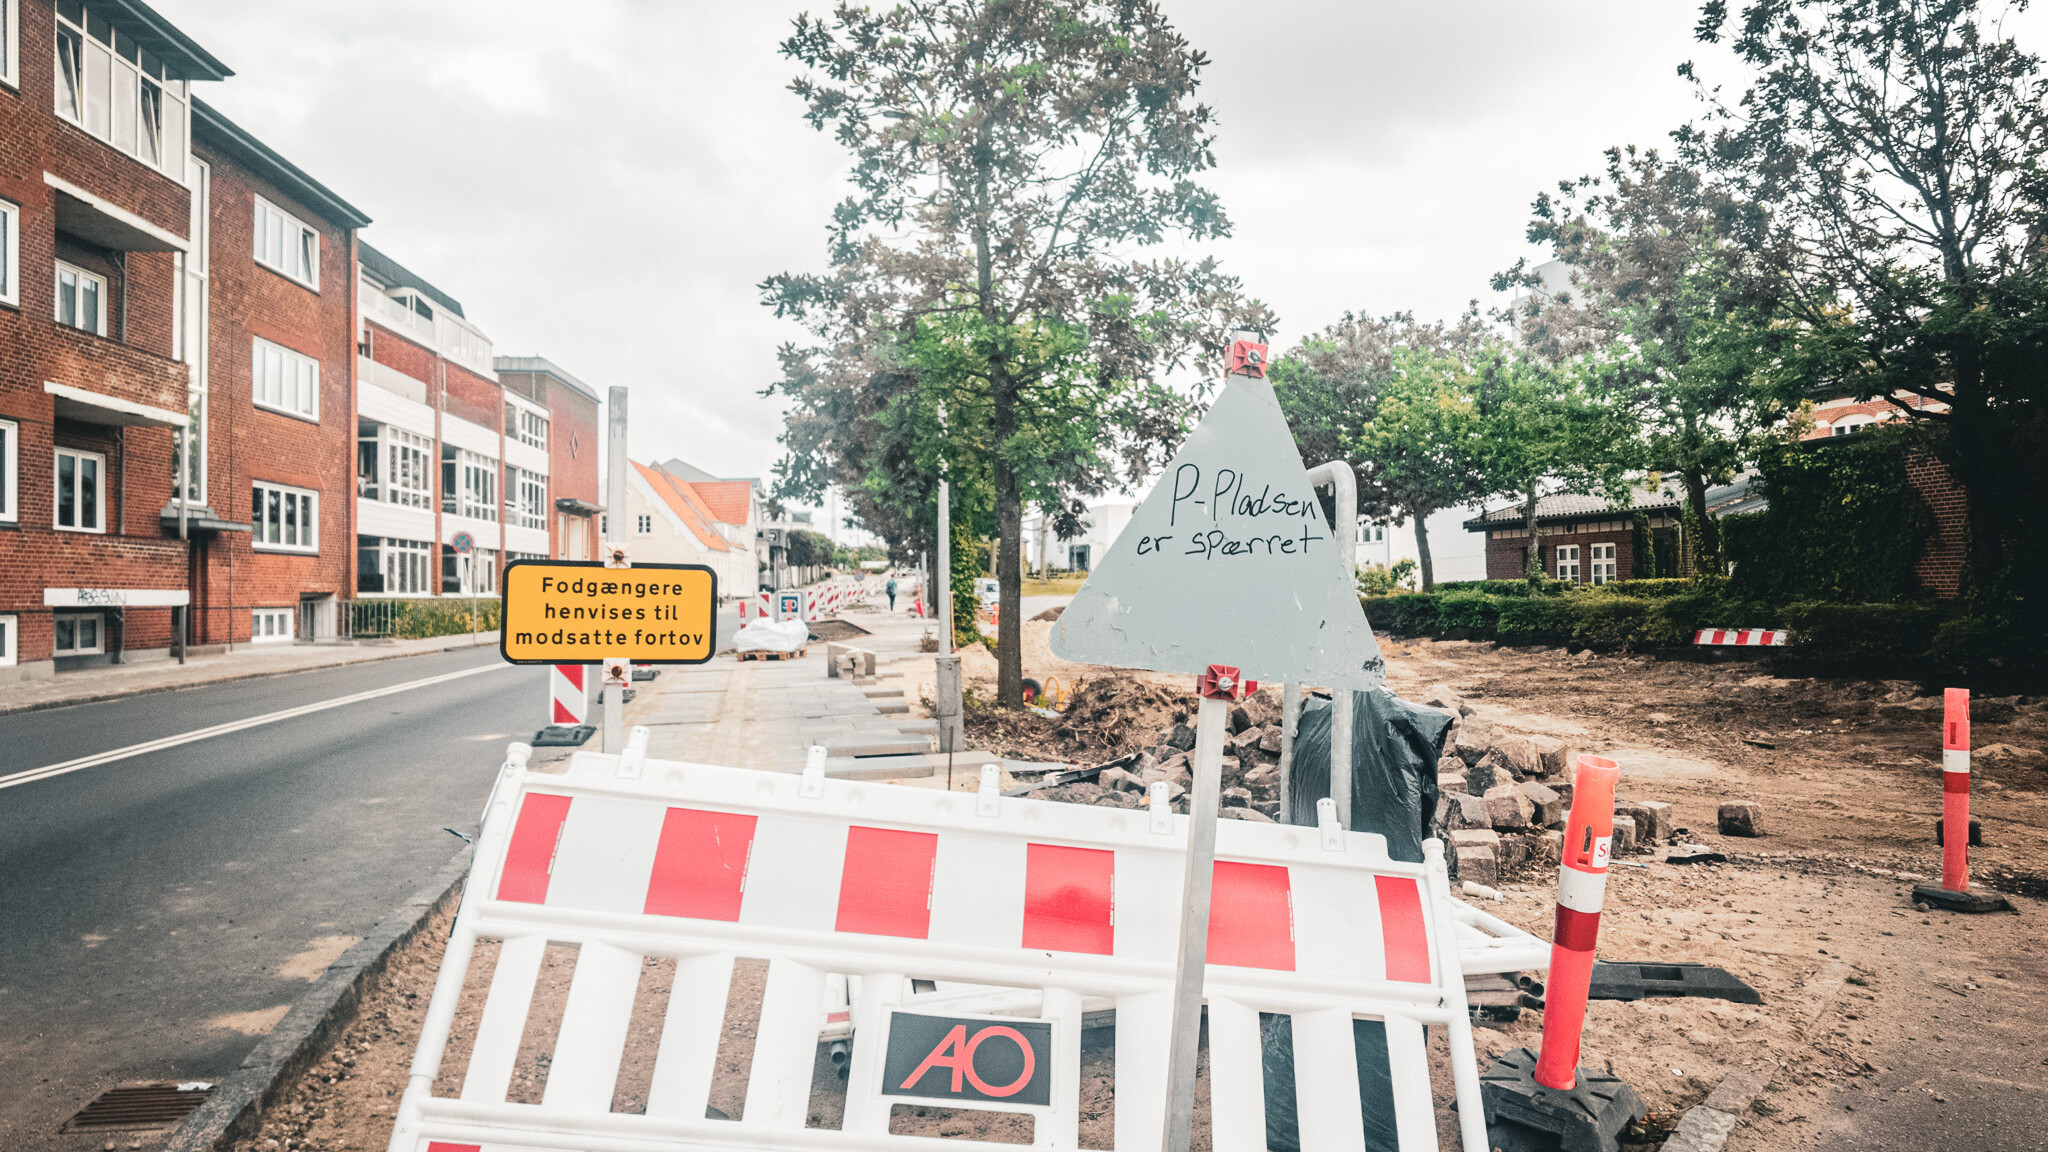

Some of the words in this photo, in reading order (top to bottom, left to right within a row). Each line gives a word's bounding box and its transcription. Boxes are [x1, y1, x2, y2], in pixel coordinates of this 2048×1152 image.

[1138, 535, 1173, 555] er
[1185, 525, 1323, 560] spærret
[542, 577, 683, 598] Fodgængere
[545, 603, 646, 619] henvises
[654, 604, 678, 620] til
[516, 628, 627, 645] modsatte
[635, 629, 703, 646] fortov
[899, 1025, 1035, 1097] AO
